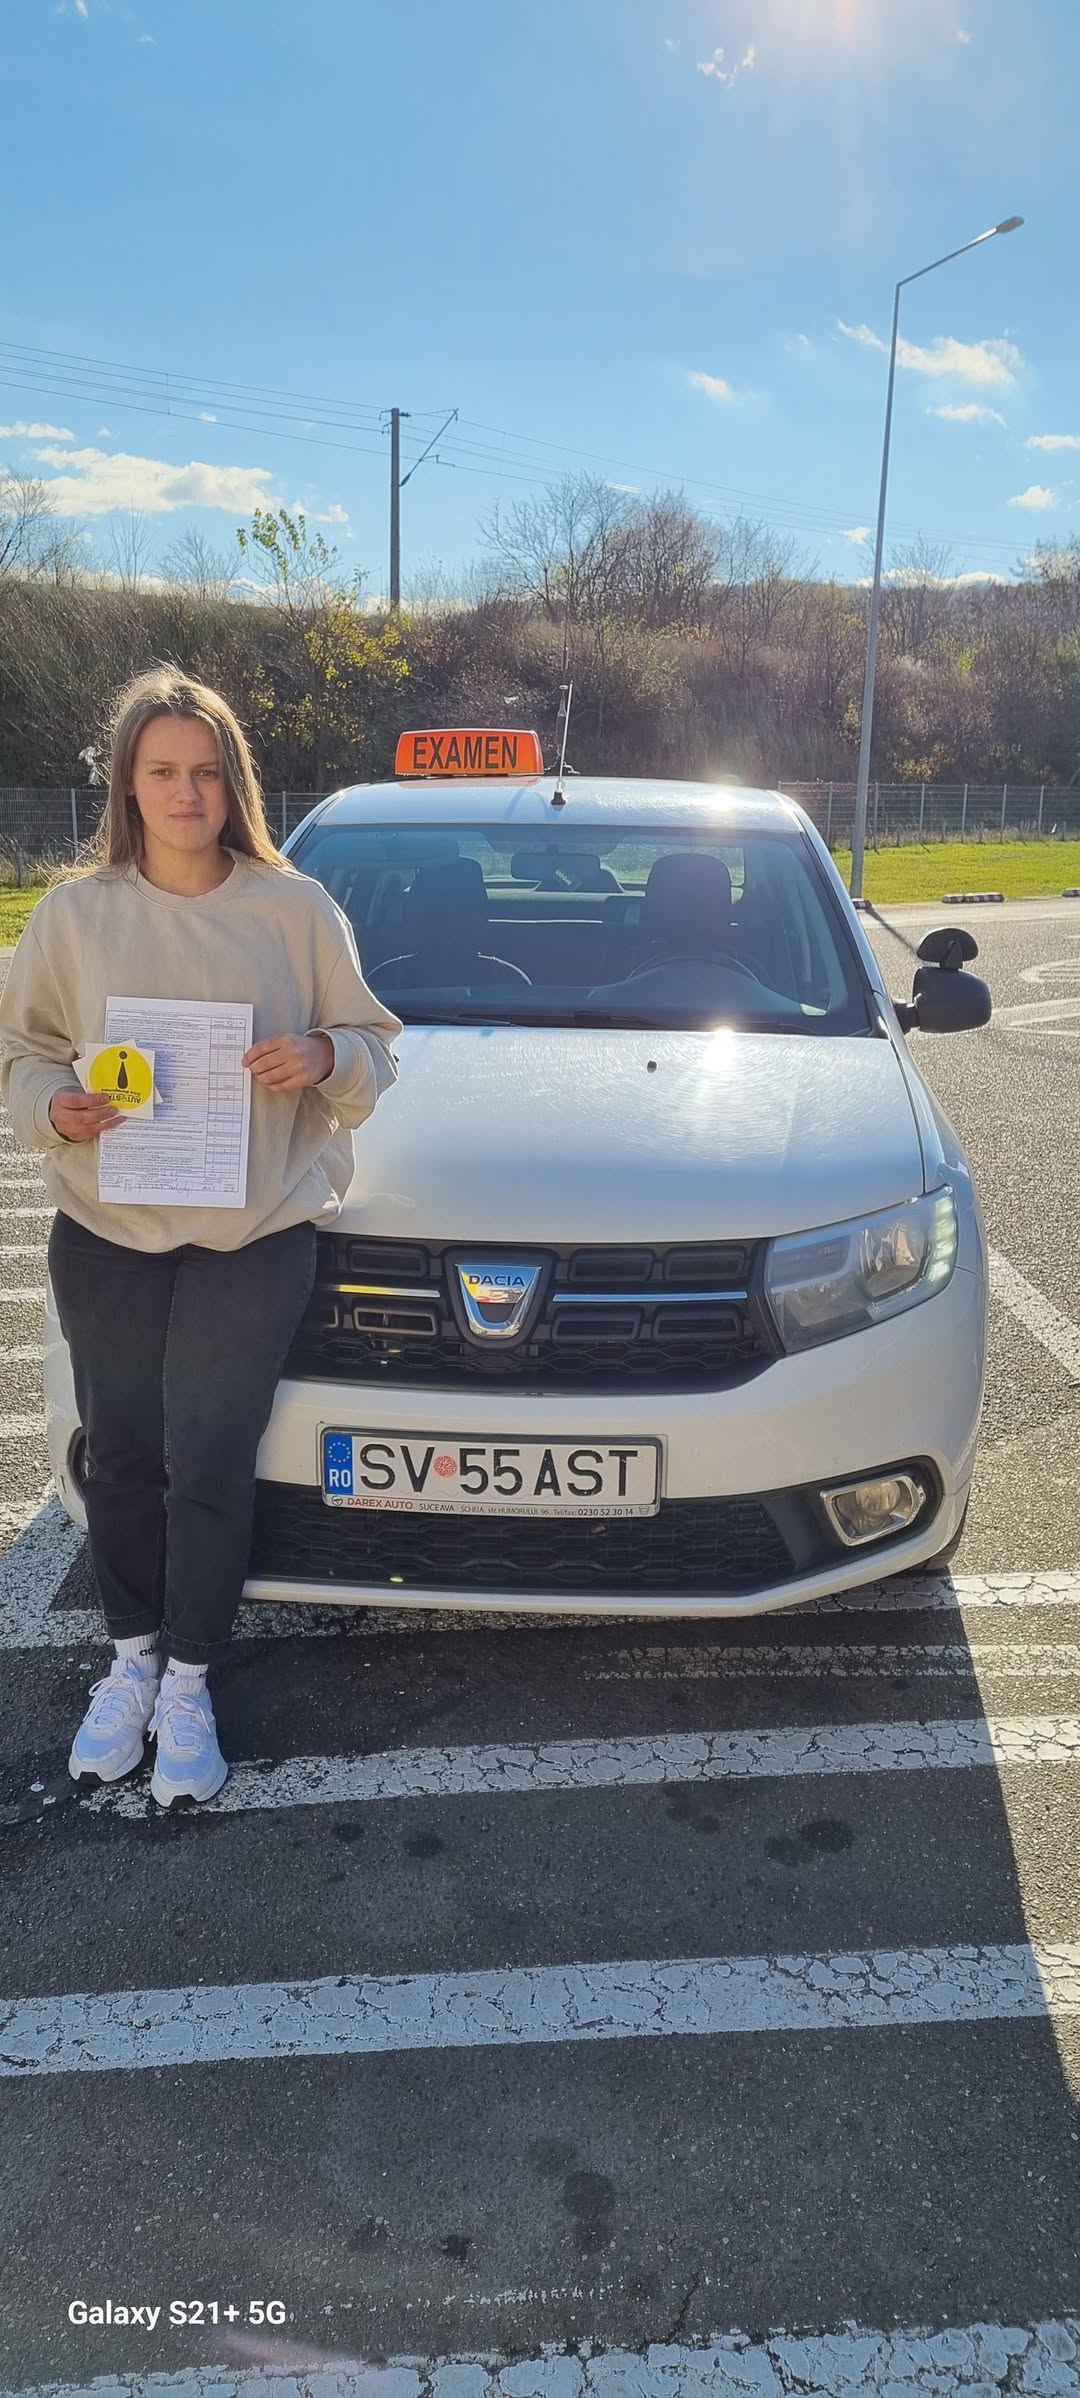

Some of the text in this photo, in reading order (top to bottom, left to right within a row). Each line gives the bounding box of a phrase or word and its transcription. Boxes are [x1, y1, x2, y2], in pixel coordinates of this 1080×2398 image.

[413, 736, 518, 769] EXAMEN
[468, 1275, 525, 1287] DACIA
[329, 1468, 352, 1488] RO
[359, 1443, 639, 1497] SV 55 AST
[347, 1497, 382, 1508] DAREX
[384, 1500, 413, 1510] AUTO
[418, 1503, 455, 1513] SUCEAVA
[577, 1508, 599, 1516] 0230
[600, 1508, 611, 1516] 52
[612, 1508, 623, 1516] 30
[625, 1508, 634, 1516] 14
